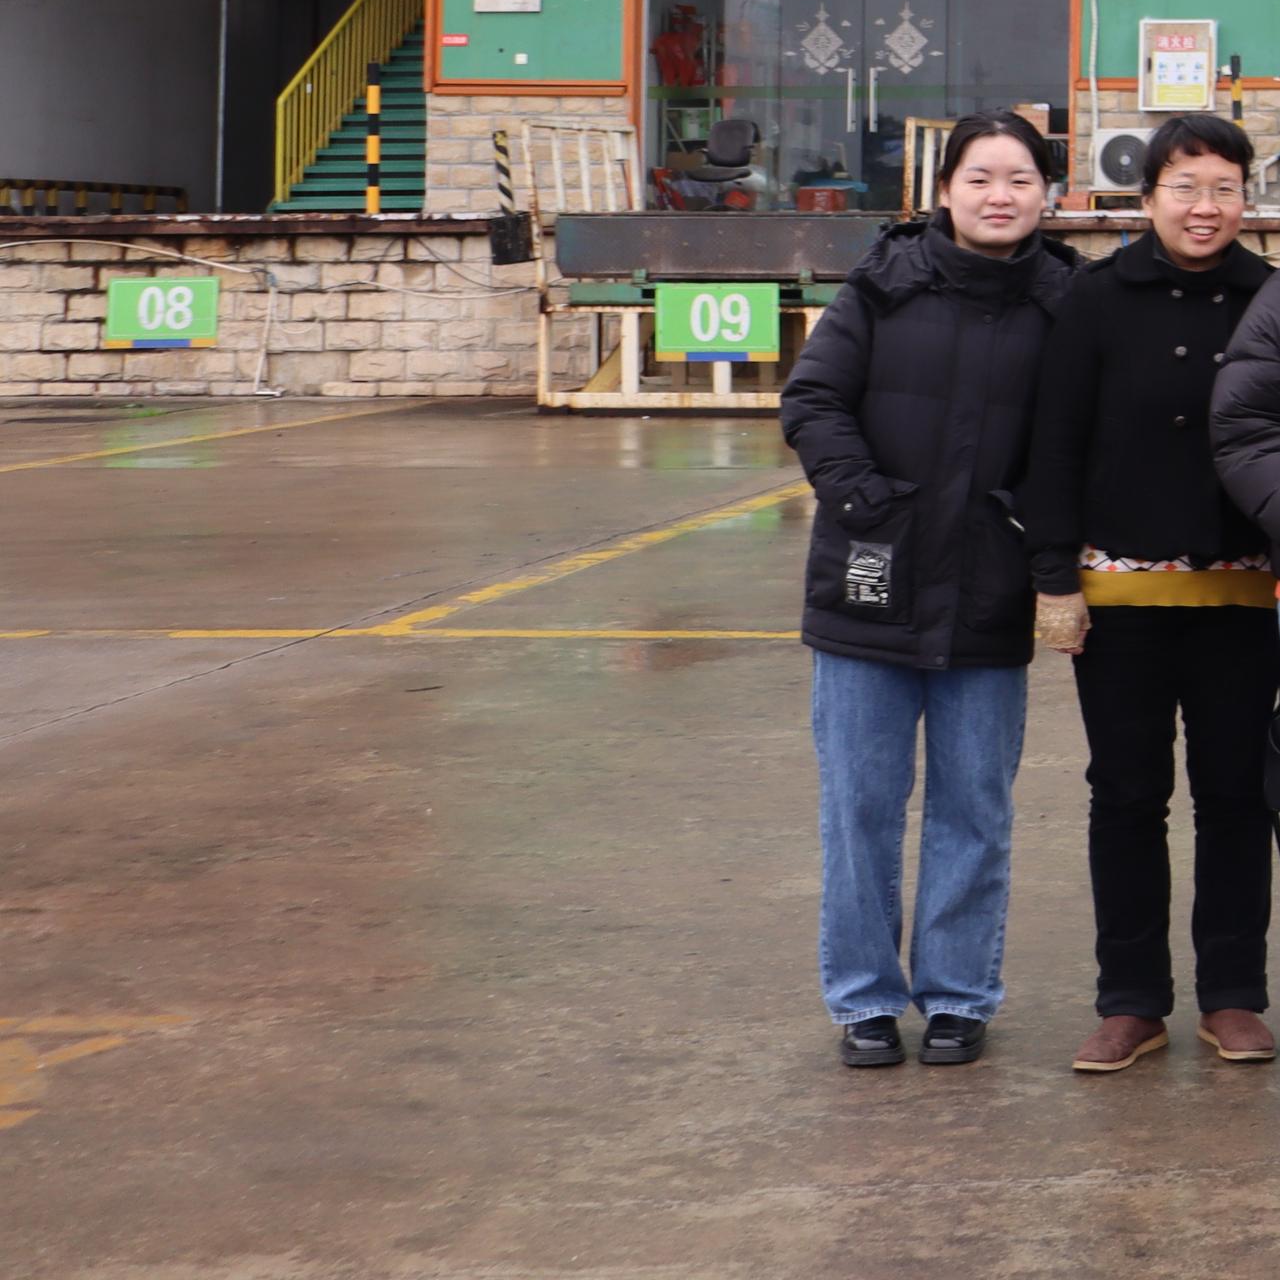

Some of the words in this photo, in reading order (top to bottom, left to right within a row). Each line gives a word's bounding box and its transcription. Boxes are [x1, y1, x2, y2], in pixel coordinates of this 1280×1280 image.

[1156, 35, 1195, 49] 消火栓
[138, 286, 193, 330] 08
[690, 293, 751, 342] 09
